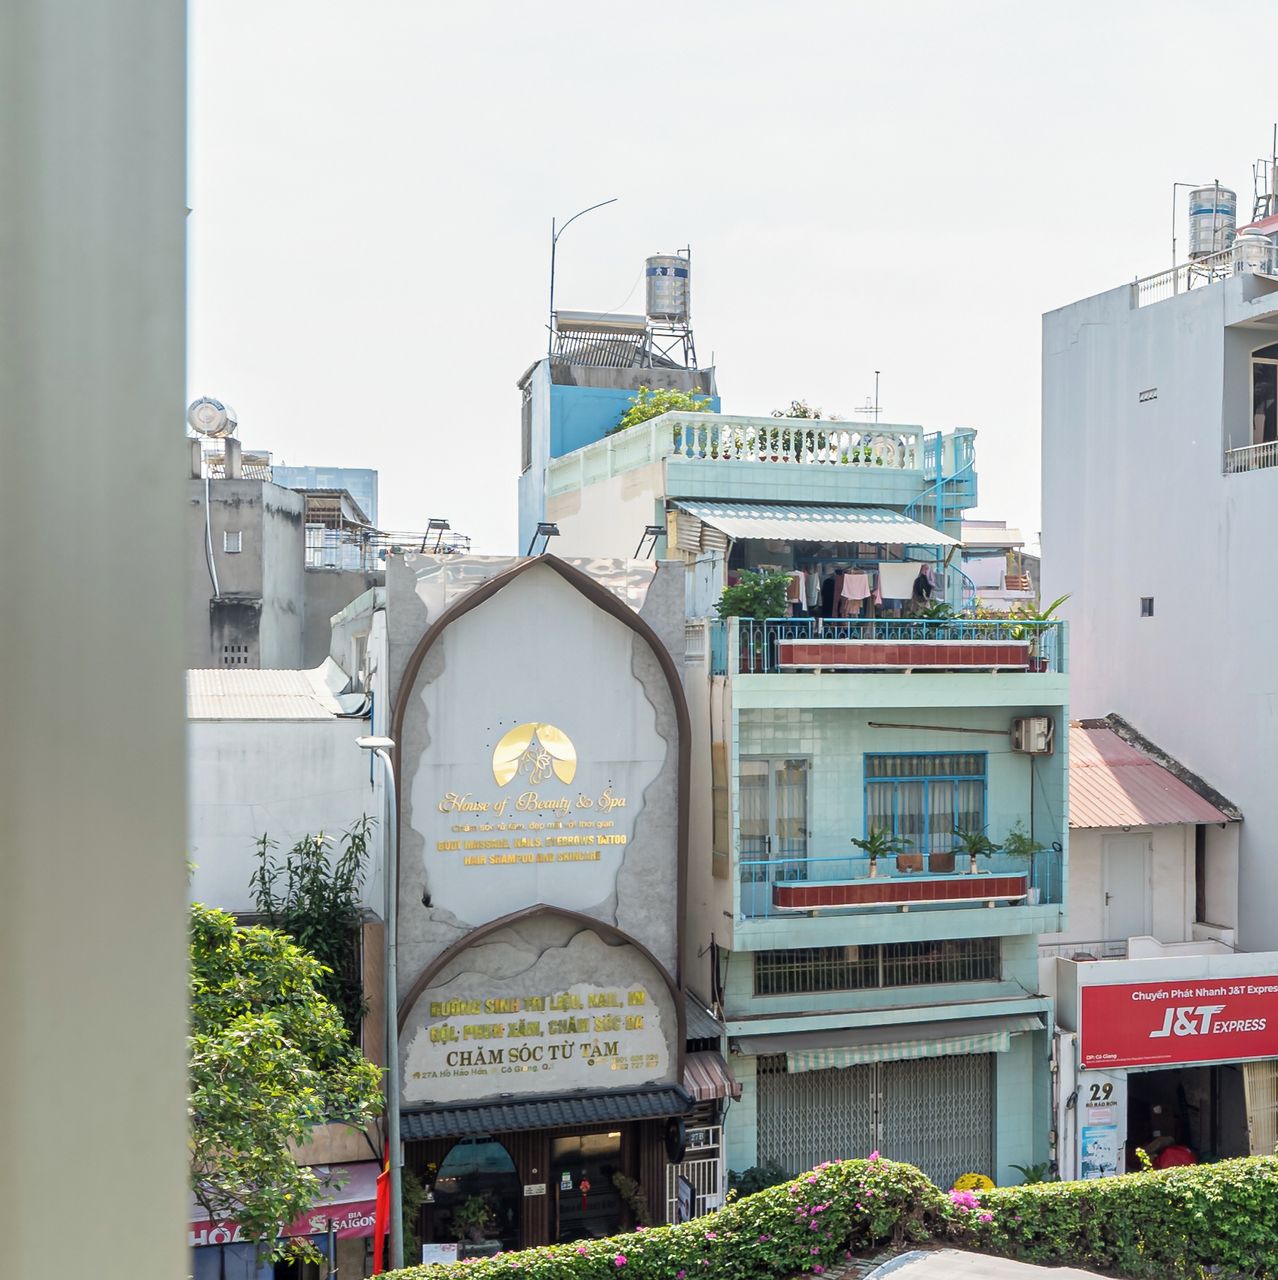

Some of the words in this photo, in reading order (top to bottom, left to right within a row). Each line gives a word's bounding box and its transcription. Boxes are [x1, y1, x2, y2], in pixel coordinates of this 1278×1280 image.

[437, 791, 489, 814] House
[493, 795, 511, 817] of
[515, 790, 572, 818] Beauty
[575, 794, 594, 809] &
[596, 788, 626, 813] Spa
[597, 834, 627, 845] TATTOO
[463, 855, 487, 866] HAIR
[489, 853, 535, 865] SHAMPOO
[1171, 987, 1194, 999] Phát
[1196, 986, 1227, 997] Nhanh
[1228, 985, 1246, 996] J&T
[484, 997, 520, 1015] SINH
[587, 991, 624, 1009] NAIL,
[1149, 1004, 1227, 1038] J&T
[1213, 1018, 1267, 1034] EXPRESS
[446, 1045, 504, 1067] CHĂM
[508, 1042, 544, 1063] SÓC
[547, 1040, 575, 1061] TỪ
[580, 1038, 619, 1058] TÂM
[421, 1071, 438, 1079] 27A
[1089, 1083, 1114, 1101] 29
[348, 1211, 362, 1219] BIA
